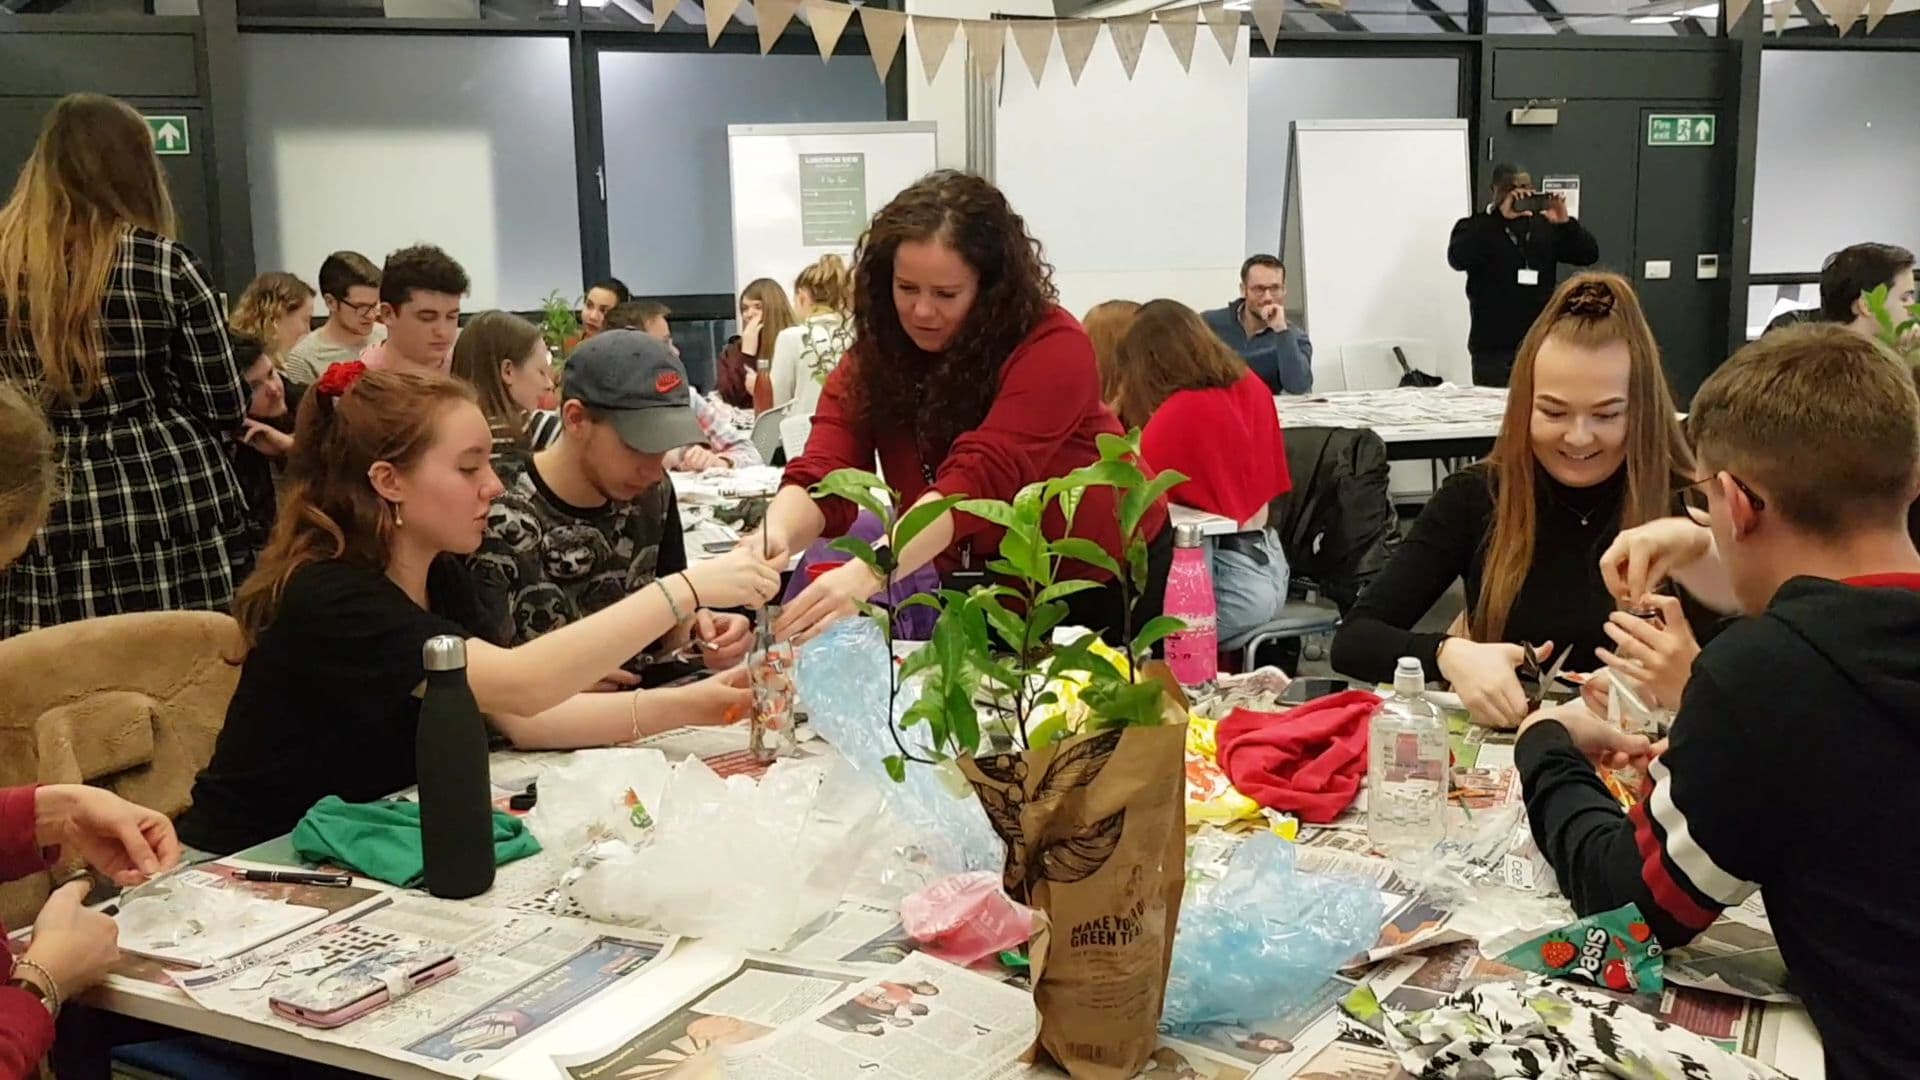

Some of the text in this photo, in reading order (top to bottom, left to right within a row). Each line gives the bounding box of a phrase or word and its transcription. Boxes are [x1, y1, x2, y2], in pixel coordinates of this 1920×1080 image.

[1653, 120, 1671, 129] Fire
[1653, 132, 1670, 140] exit
[1072, 915, 1111, 936] MAKE
[1070, 931, 1116, 948] GREEN
